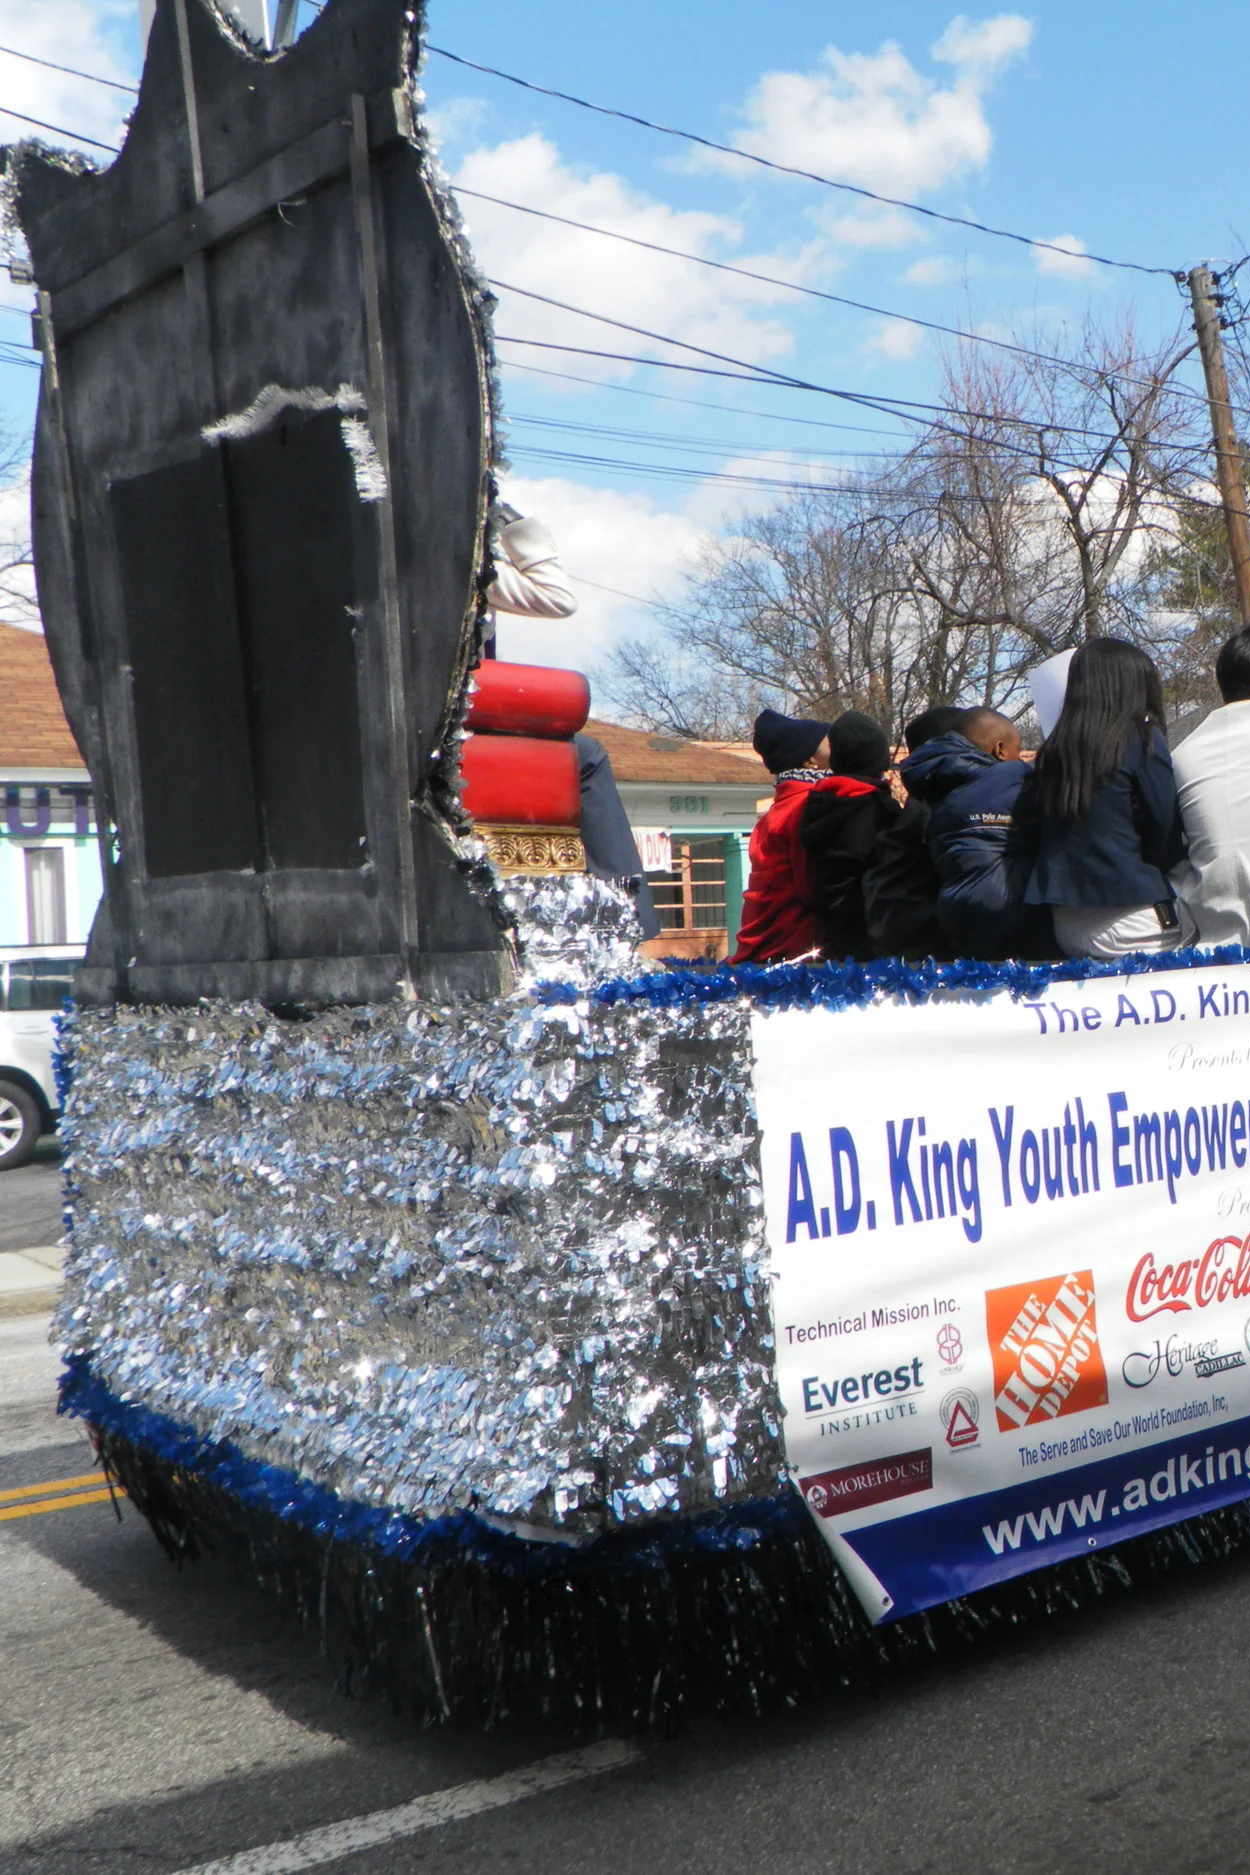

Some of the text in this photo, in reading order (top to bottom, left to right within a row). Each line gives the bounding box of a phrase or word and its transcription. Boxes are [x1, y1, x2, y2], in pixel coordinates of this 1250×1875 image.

[1023, 1001, 1102, 1034] The
[1115, 989, 1186, 1027] A.D.
[1168, 1041, 1242, 1072] Presents
[786, 1127, 877, 1244] A.D.
[885, 1116, 983, 1244] King
[988, 1097, 1100, 1207] Youth
[785, 1297, 961, 1345] Technical Mission Inc.
[999, 1292, 1047, 1357] THE
[995, 1272, 1096, 1428] HOME
[1039, 1317, 1099, 1419] DEPOT
[1122, 1334, 1218, 1388] Heritage
[1194, 1353, 1246, 1376] CADILLAC
[802, 1357, 924, 1413] Everest
[820, 1401, 917, 1436] INSTITUTE
[1019, 1447, 1038, 1467] The
[1040, 1441, 1068, 1463] Serve
[1070, 1431, 1088, 1453] and
[1089, 1428, 1113, 1448] Save
[1114, 1420, 1131, 1440] Our
[1132, 1410, 1160, 1435] World
[1160, 1400, 1212, 1427] Foundation,
[830, 1460, 929, 1497] MOREHOUSE
